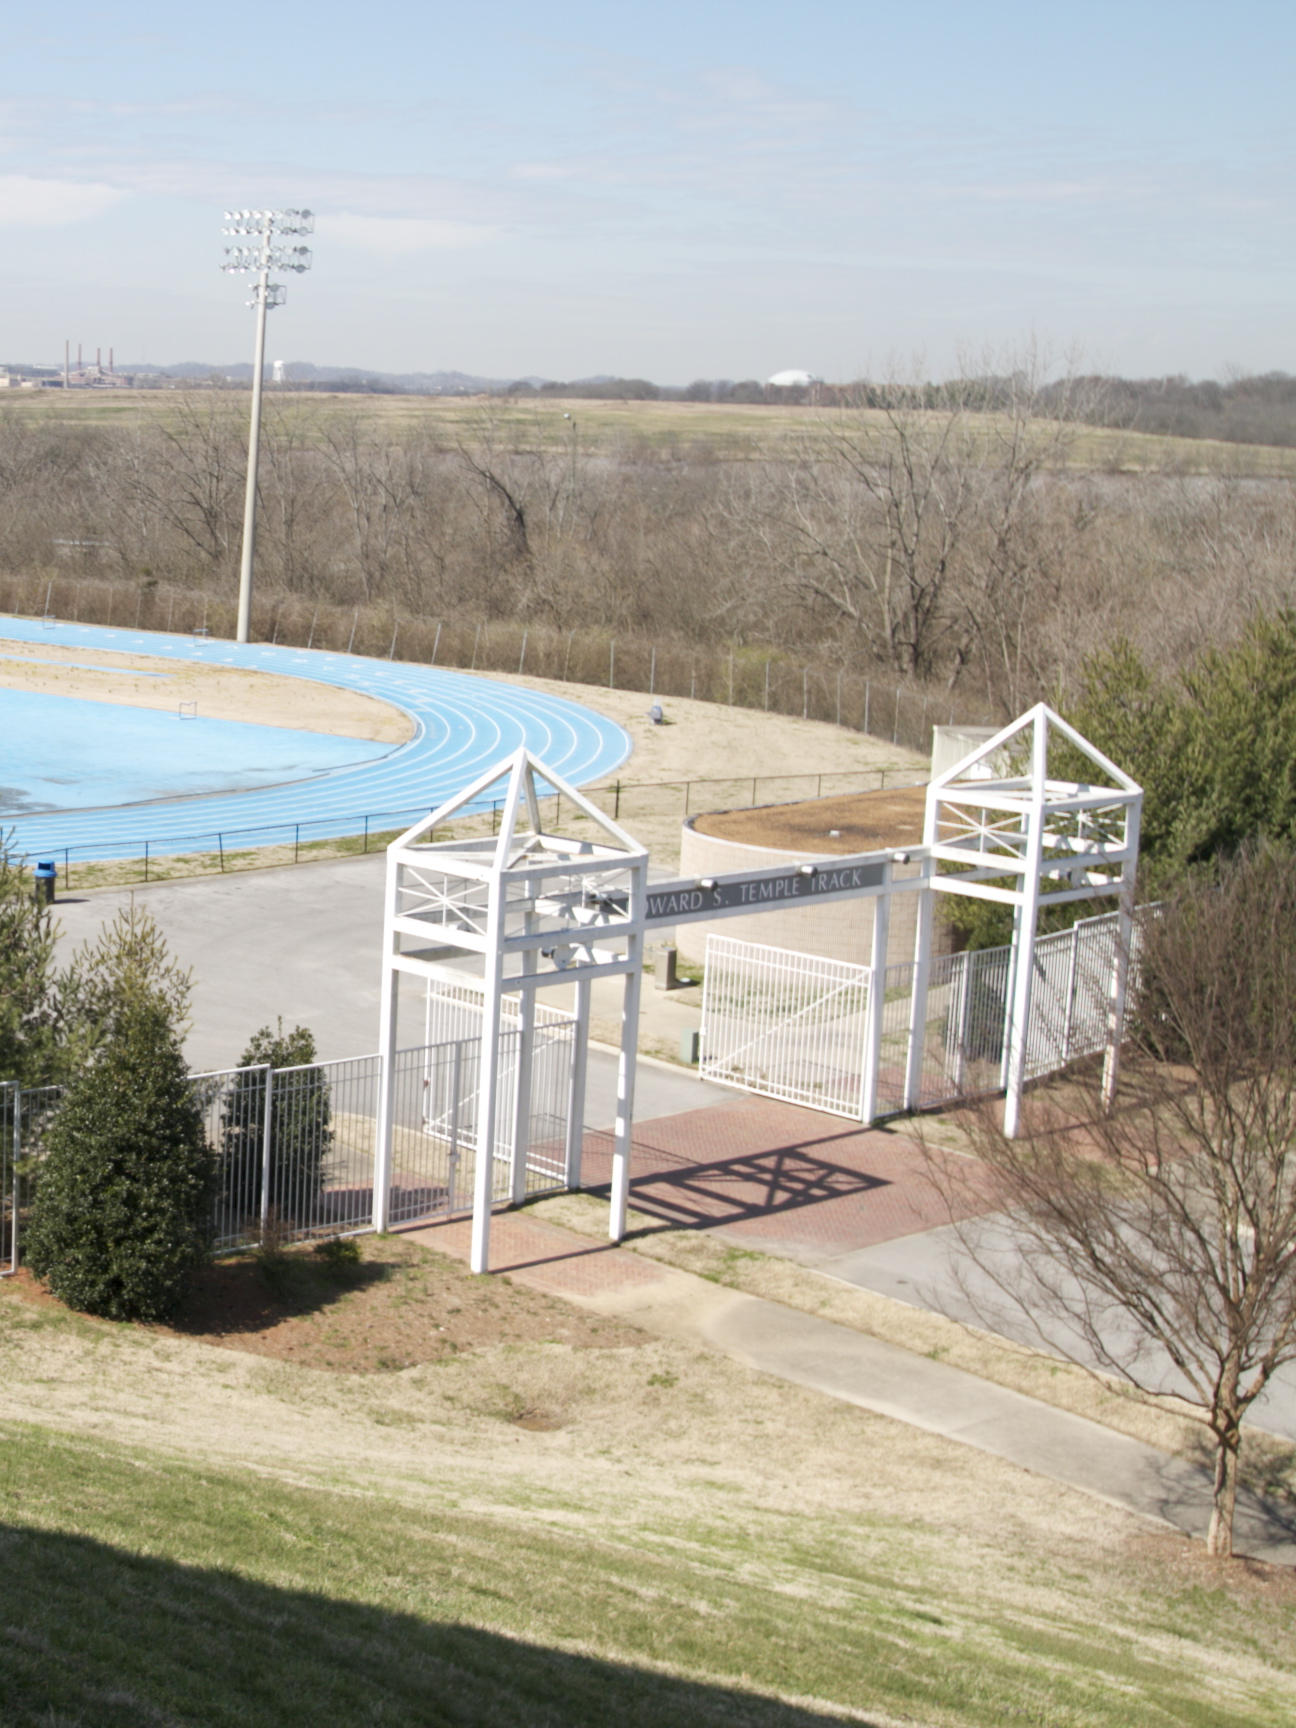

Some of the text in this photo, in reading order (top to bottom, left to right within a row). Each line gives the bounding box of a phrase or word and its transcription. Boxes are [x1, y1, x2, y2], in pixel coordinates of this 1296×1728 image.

[645, 891, 703, 915] WARD
[713, 887, 729, 907] S.
[740, 877, 800, 903] TEMPLE
